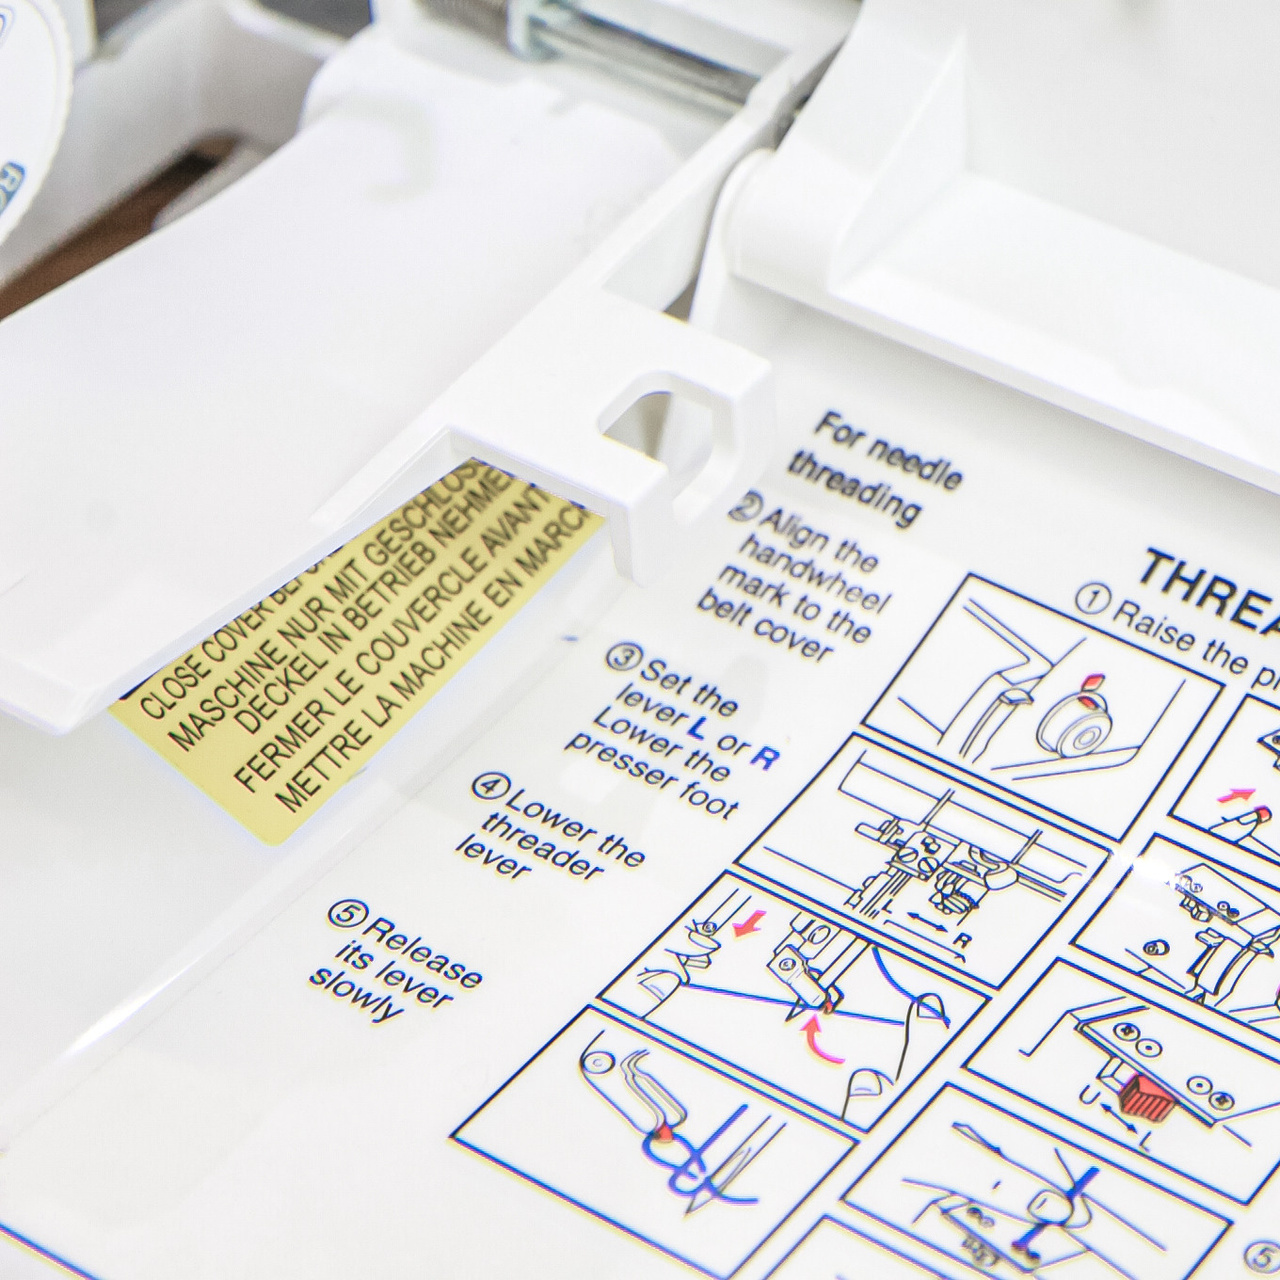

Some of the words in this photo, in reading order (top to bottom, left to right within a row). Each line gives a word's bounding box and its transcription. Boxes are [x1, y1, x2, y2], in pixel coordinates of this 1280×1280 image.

[787, 449, 923, 528] threading
[814, 410, 866, 448] For
[867, 438, 963, 491] needle
[738, 533, 892, 615] handwheel
[759, 507, 829, 550] Align
[833, 539, 879, 574] the
[233, 652, 329, 735] DECKEL
[317, 623, 353, 655] IN
[342, 540, 437, 631] BETRIEB
[697, 588, 753, 627] belt
[753, 617, 834, 663] cover
[717, 564, 790, 608] mark
[793, 594, 822, 622] to
[826, 610, 872, 644] the
[1113, 599, 1196, 652] Raise
[1201, 639, 1249, 675] the
[140, 654, 212, 721] CLOSE
[167, 639, 289, 752] MASCHINE
[277, 596, 335, 649] NUR
[323, 558, 368, 605] MIT
[233, 699, 335, 794] FERMER
[323, 669, 364, 707] LE
[355, 546, 488, 676] COUVERCLE
[275, 719, 373, 814] METTRE
[361, 694, 402, 729] LA
[389, 600, 493, 703] MACHINE
[483, 568, 524, 609] EN
[640, 659, 692, 696] Set
[692, 684, 739, 717] the
[593, 706, 684, 758] Lower
[684, 749, 731, 782] the
[615, 682, 690, 727] lever
[686, 715, 707, 741] L
[717, 735, 752, 756] or
[750, 746, 781, 771] R
[564, 732, 679, 790] presser
[679, 781, 739, 820] foot
[455, 833, 532, 880] lever
[481, 812, 605, 880] threader
[505, 788, 598, 842] Lower
[597, 834, 646, 868] the
[334, 940, 374, 971] its
[375, 960, 454, 1009] lever
[362, 916, 483, 989] Release
[309, 967, 405, 1024] slowly
